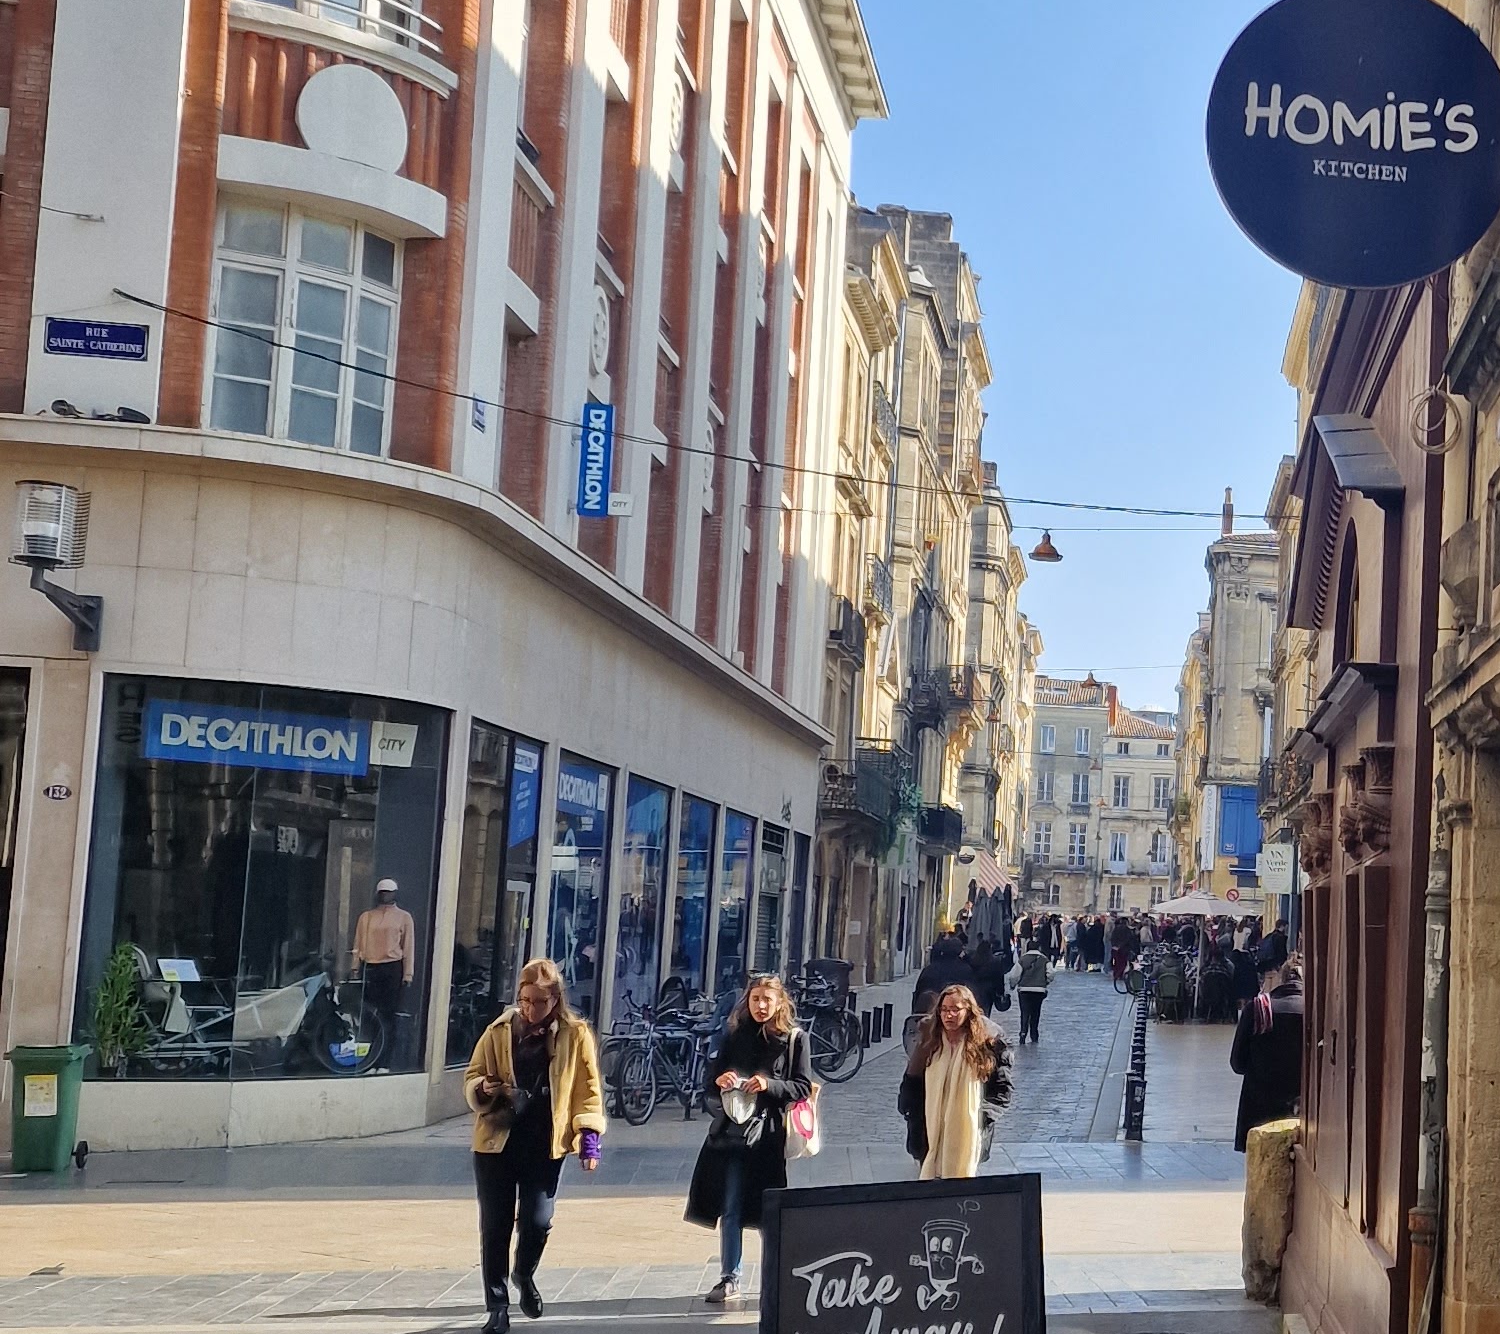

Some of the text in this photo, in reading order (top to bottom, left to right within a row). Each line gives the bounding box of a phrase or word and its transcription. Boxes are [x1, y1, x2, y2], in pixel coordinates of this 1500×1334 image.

[1312, 158, 1408, 183] KITCHEN
[85, 326, 109, 338] RUE
[583, 408, 607, 510] DECATHLON
[160, 712, 358, 762] DECATHLON
[377, 737, 406, 752] CITY
[48, 786, 69, 799] 132
[558, 771, 599, 809] DECATHLON
[791, 1250, 902, 1317] Take
